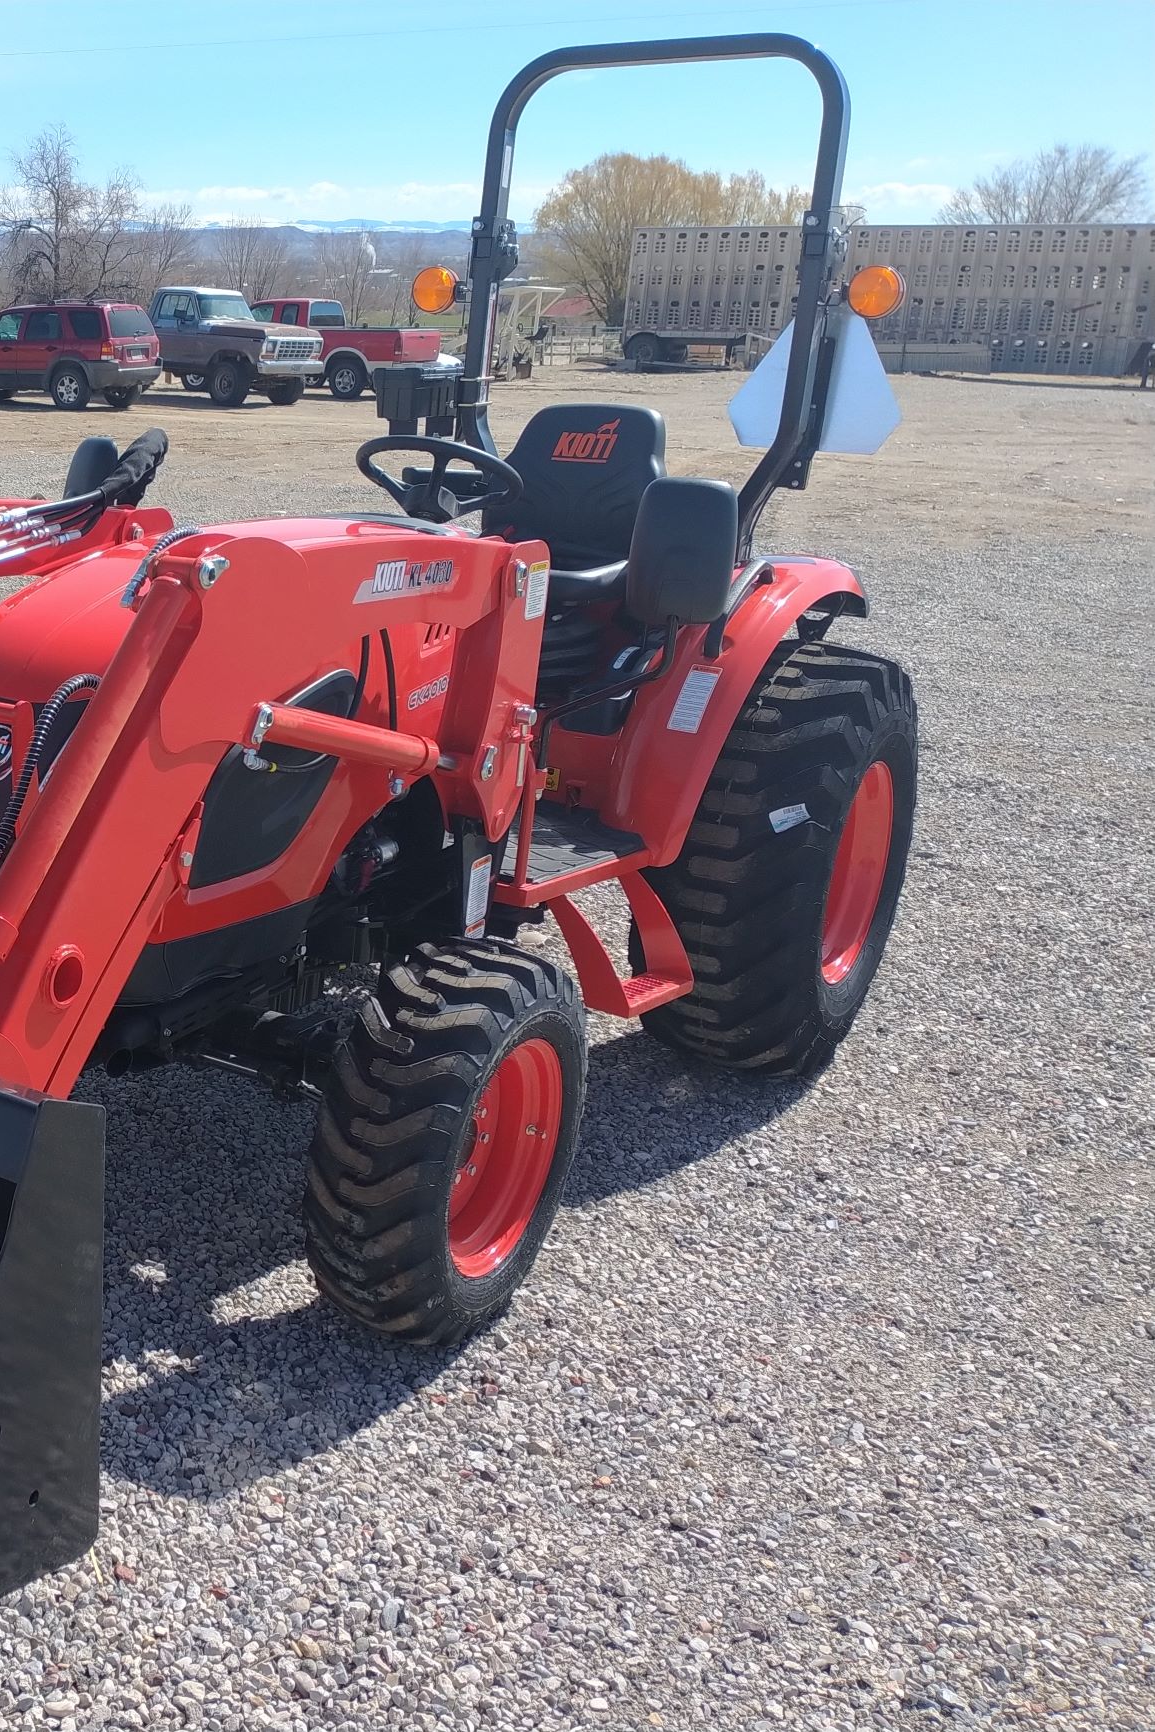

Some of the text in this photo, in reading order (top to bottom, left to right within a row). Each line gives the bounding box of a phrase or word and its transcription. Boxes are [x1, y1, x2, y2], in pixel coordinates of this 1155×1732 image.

[552, 431, 618, 459] KIOTI
[372, 559, 407, 594] KIOTI
[408, 562, 423, 588] KL
[408, 675, 449, 710] CK4010
